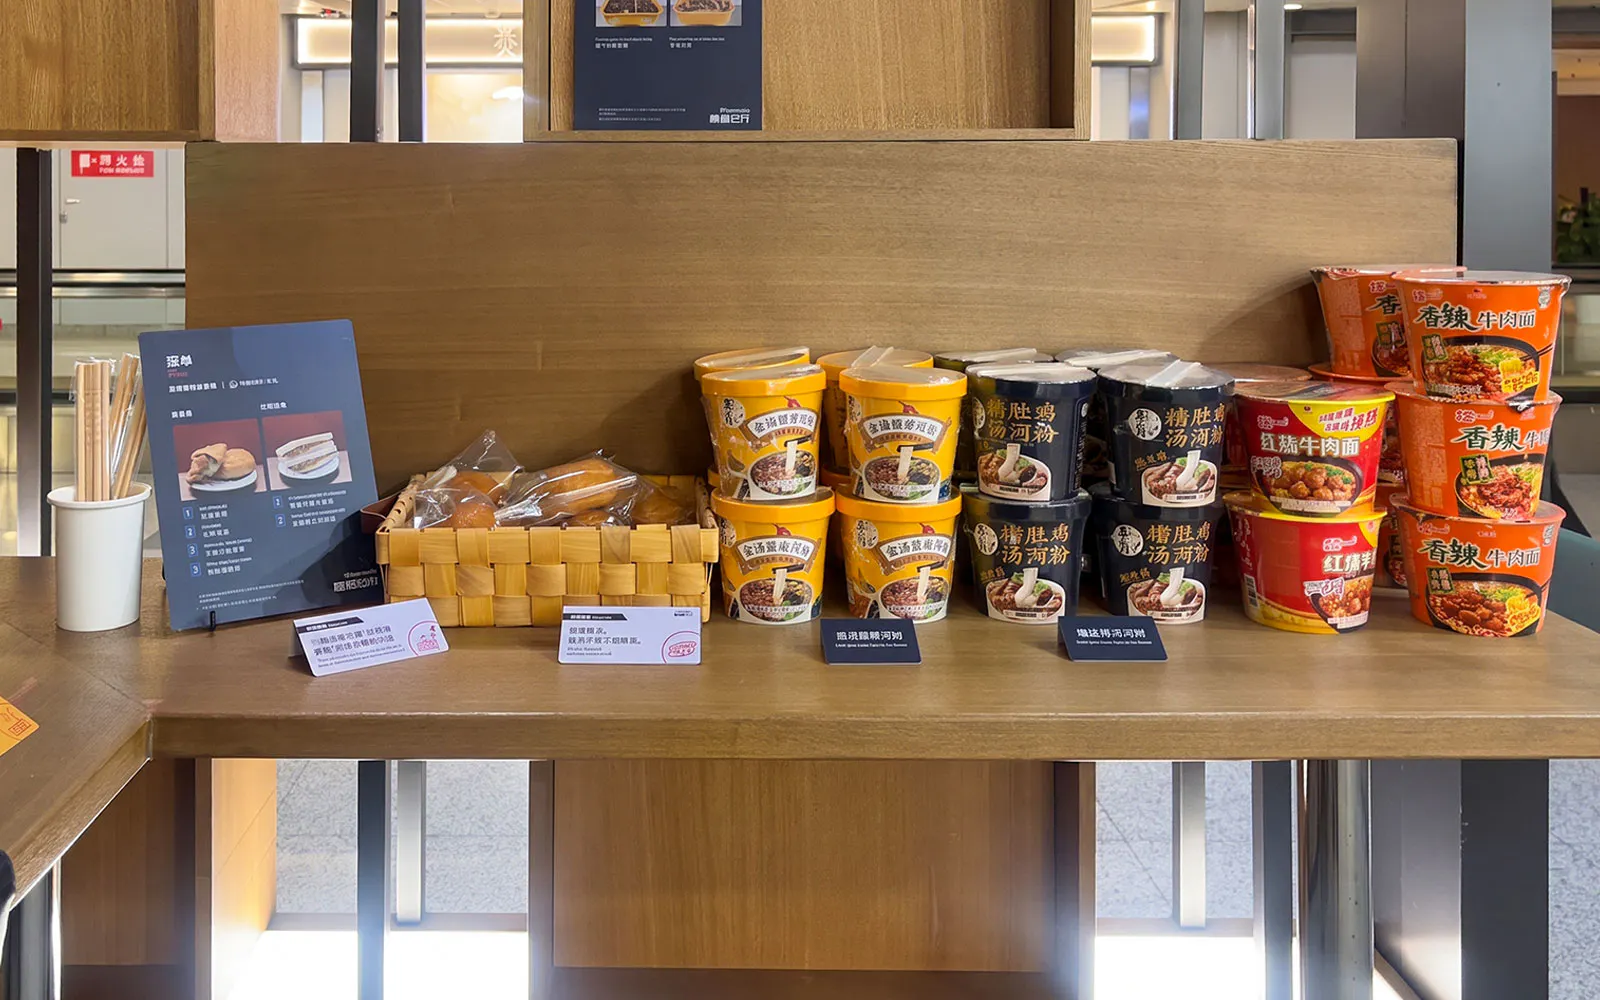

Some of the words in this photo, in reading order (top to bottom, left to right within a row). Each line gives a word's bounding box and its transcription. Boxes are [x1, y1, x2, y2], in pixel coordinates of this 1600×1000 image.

[1414, 303, 1536, 332] 香辣牛肉面
[1417, 538, 1541, 571] 香辣牛肉面
